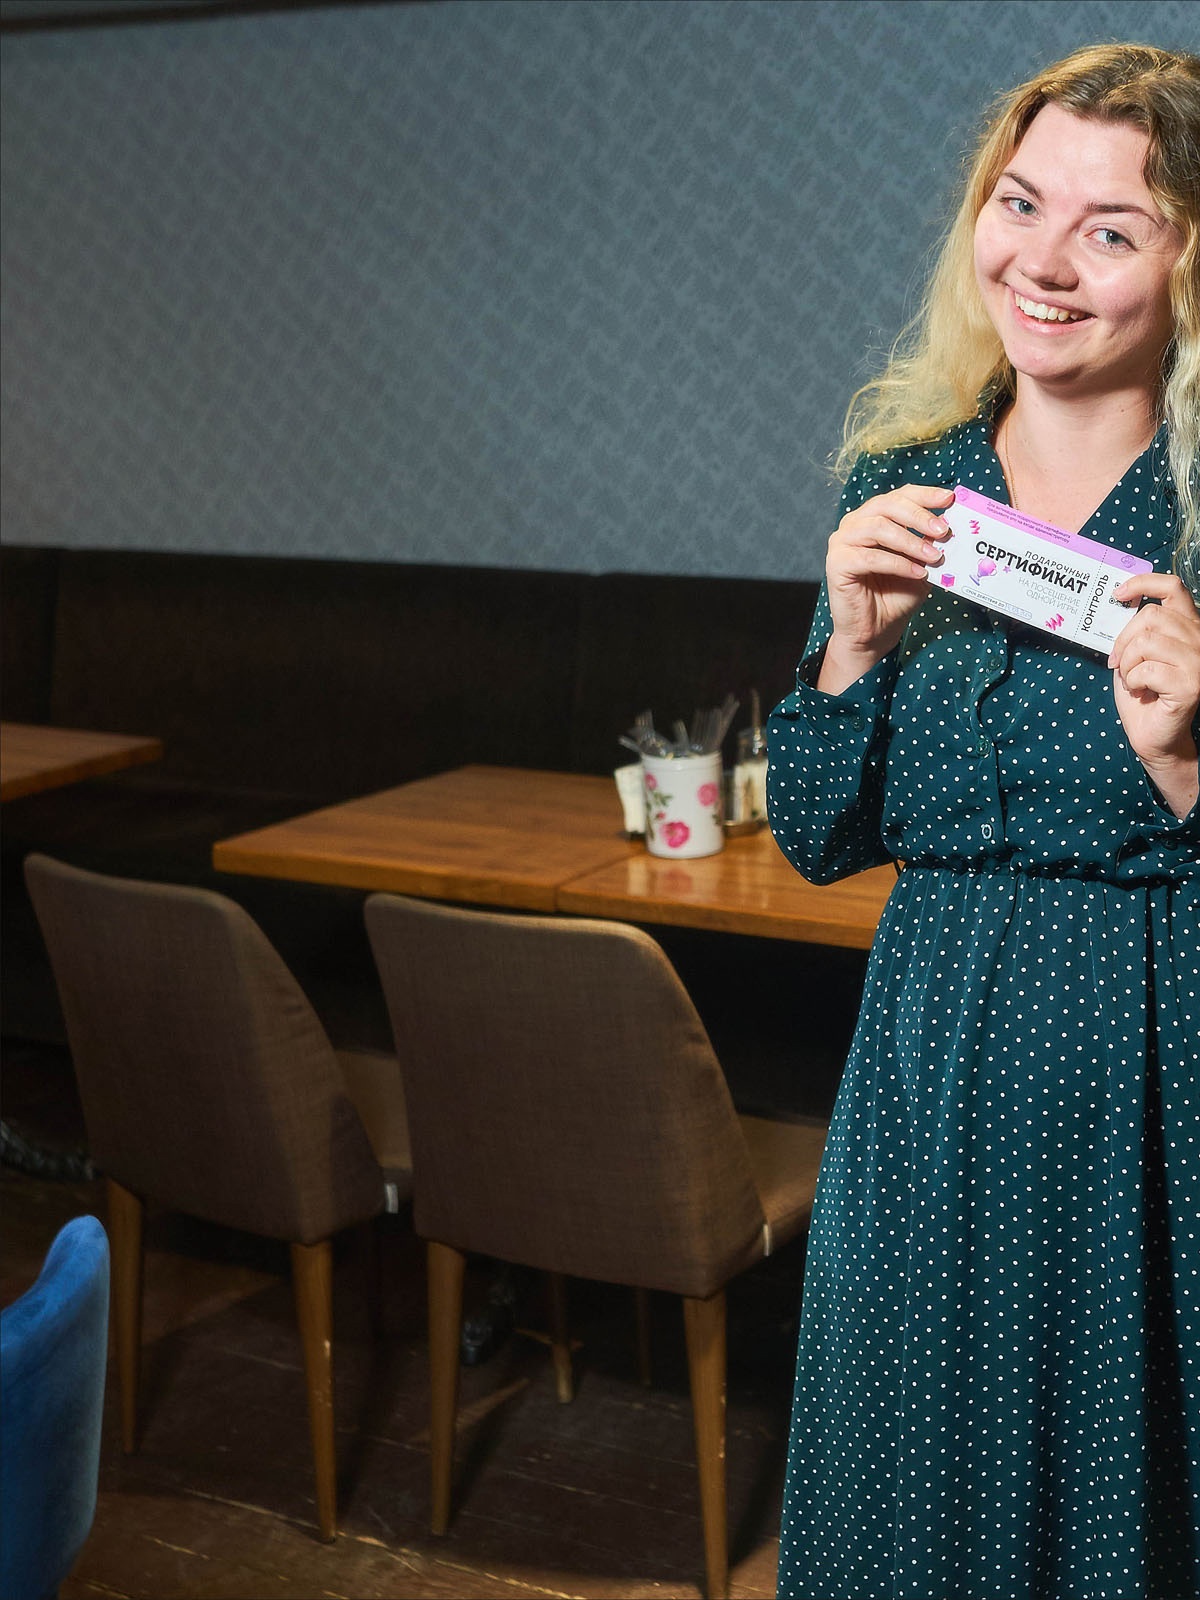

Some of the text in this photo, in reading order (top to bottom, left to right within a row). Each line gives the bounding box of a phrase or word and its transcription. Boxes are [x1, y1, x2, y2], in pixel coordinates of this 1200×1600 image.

[975, 540, 1088, 595] СЕРТИФИКАТ
[1025, 550, 1091, 582] ПОДАРОЧНЫЙ
[1018, 576, 1081, 607] НА ПОСЕЩЕНИЕ
[1026, 589, 1079, 616] ОДНОЙ ИГРЫ
[1082, 574, 1110, 632] КОНТРОЛЬ
